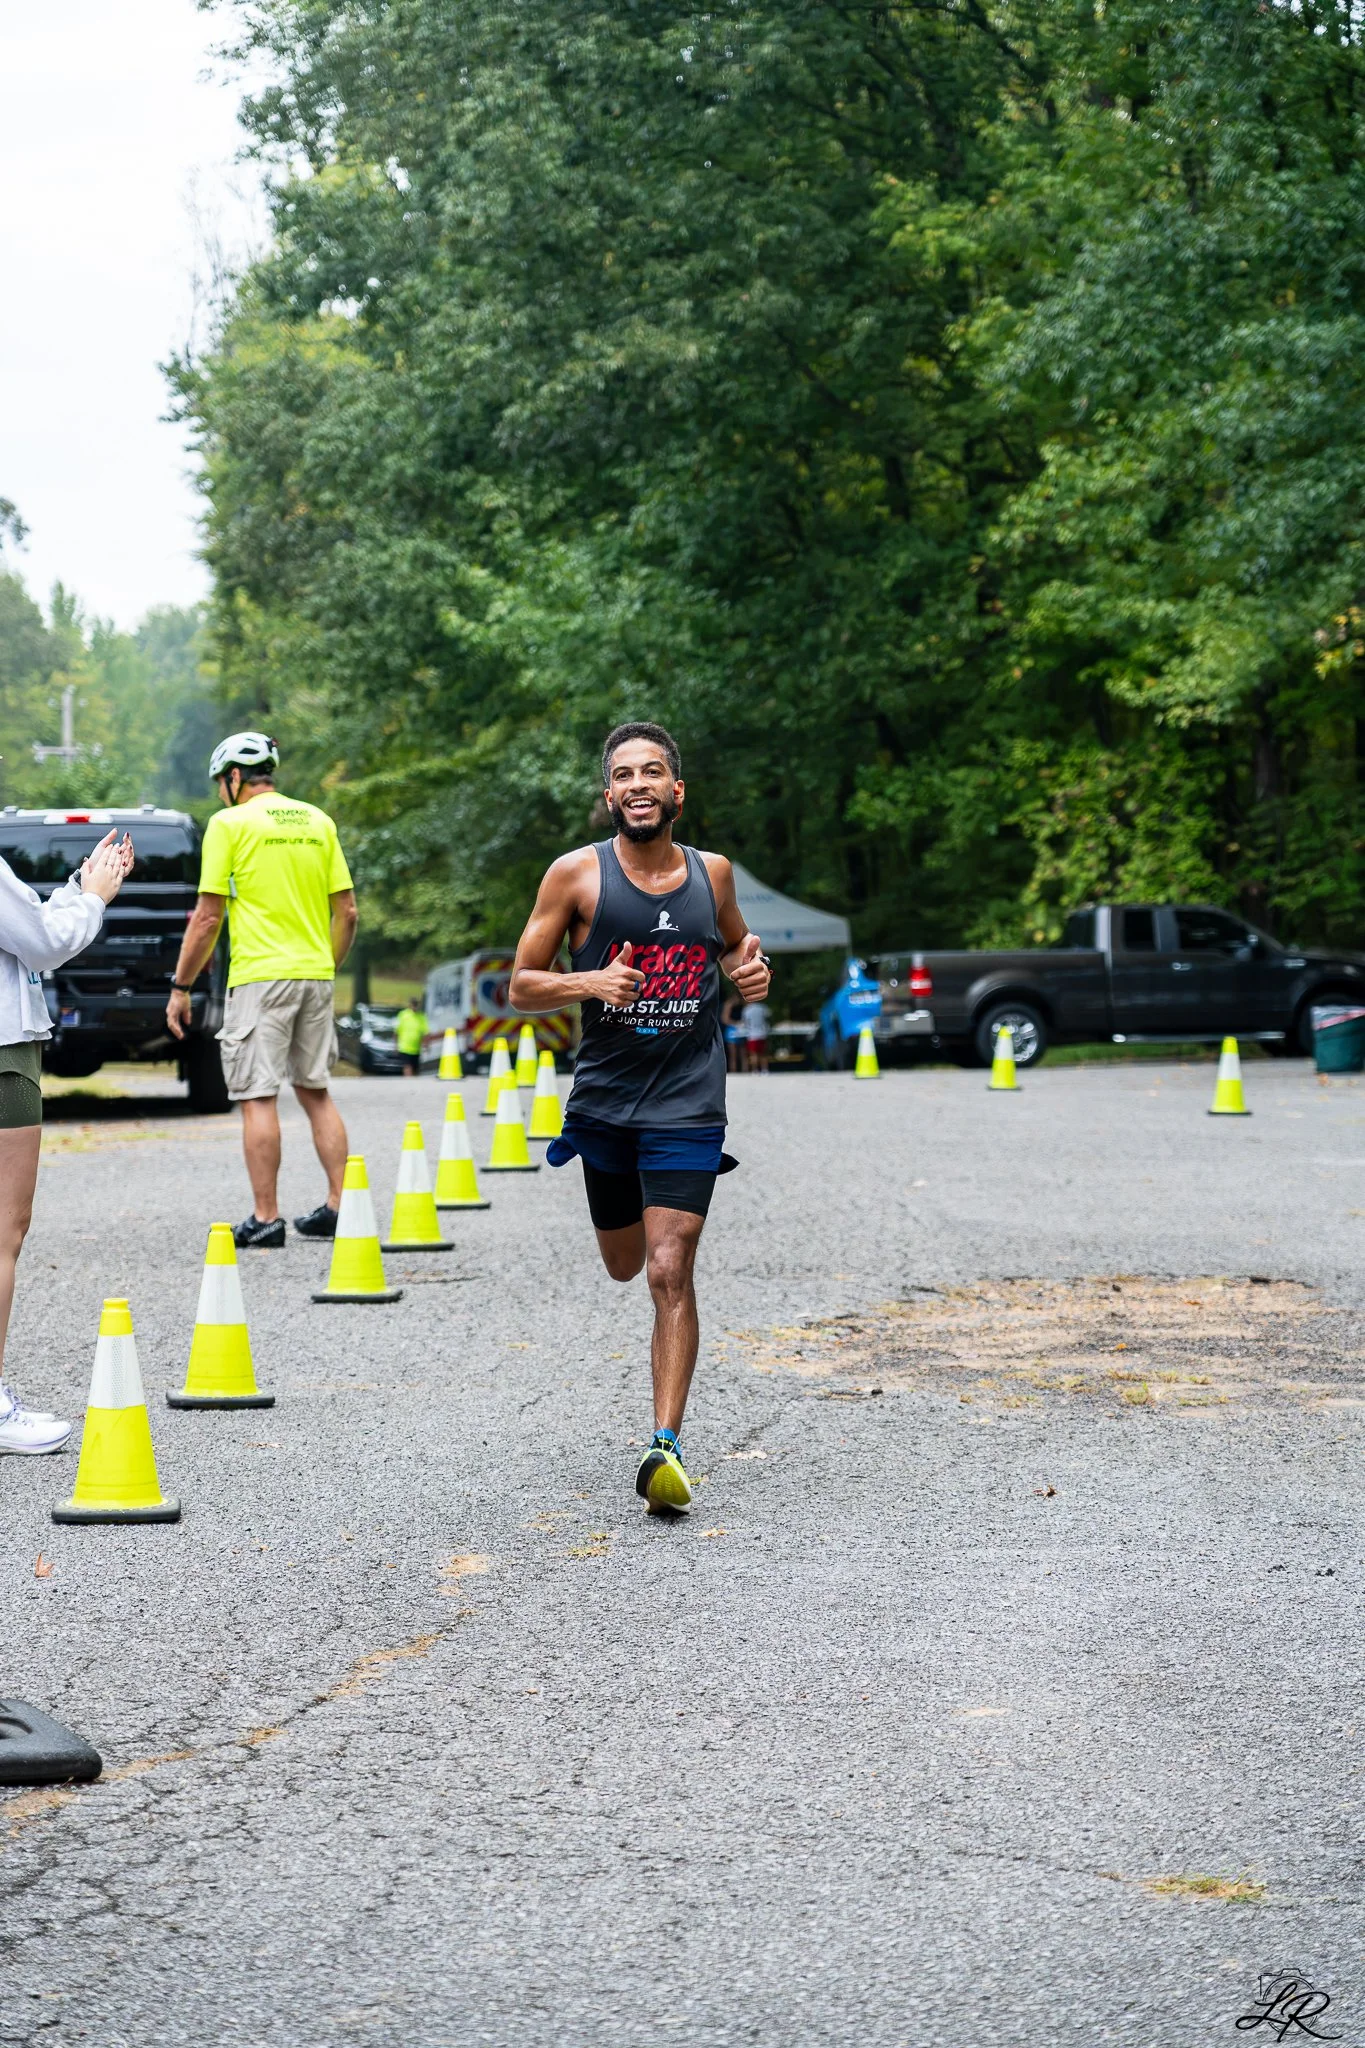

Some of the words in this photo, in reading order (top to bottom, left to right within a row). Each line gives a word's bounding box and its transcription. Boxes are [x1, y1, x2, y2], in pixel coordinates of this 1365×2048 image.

[637, 1001, 659, 1014] ST.
[662, 1000, 700, 1013] JUDE
[617, 1016, 645, 1026] JUDE
[648, 1018, 670, 1027] RUN
